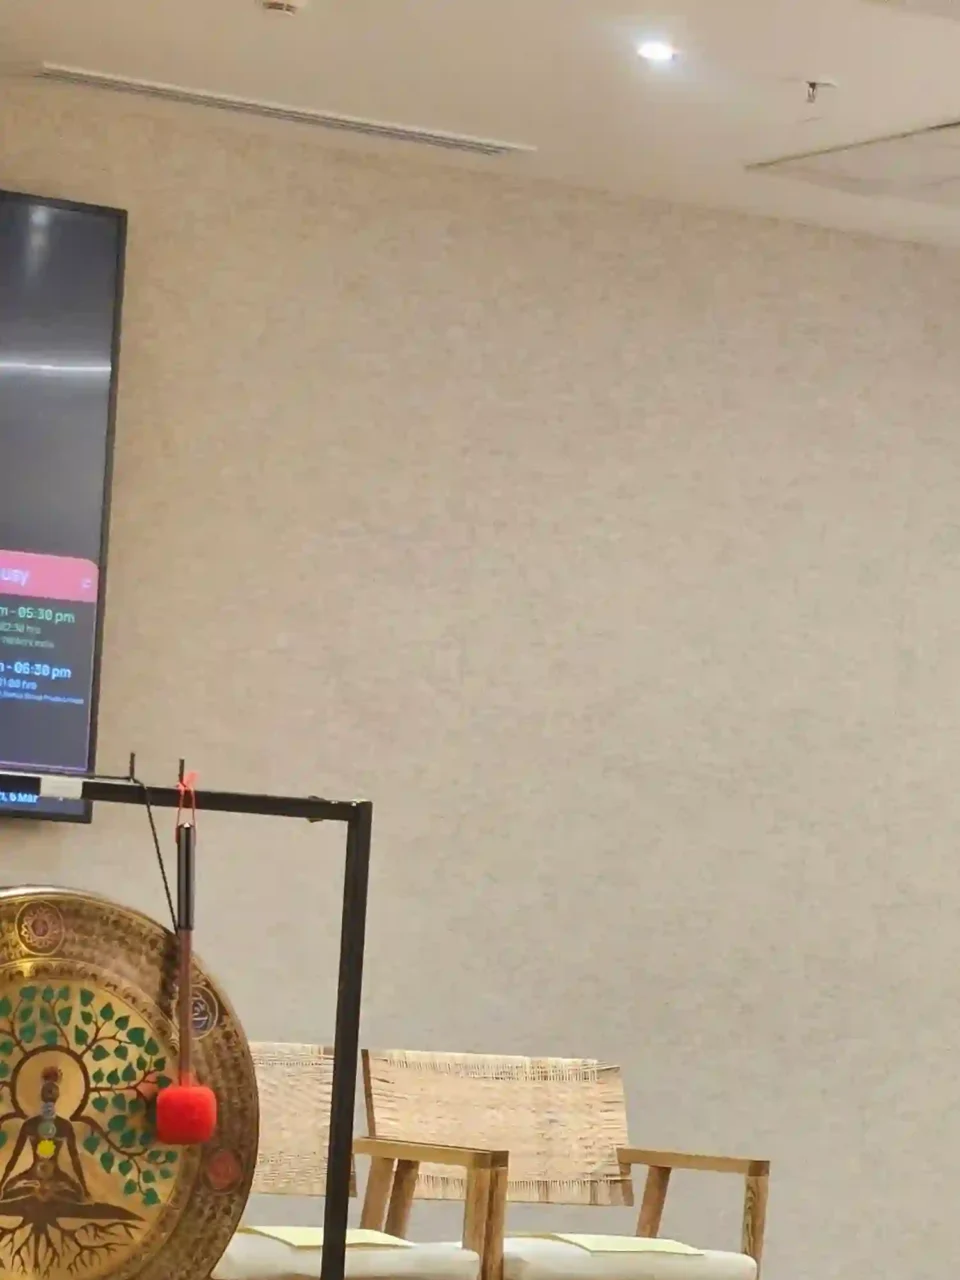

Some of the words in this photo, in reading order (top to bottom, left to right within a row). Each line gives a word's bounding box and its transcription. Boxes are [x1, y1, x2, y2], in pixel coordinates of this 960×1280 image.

[0, 566, 29, 587] usy
[18, 606, 53, 621] 05:30
[55, 611, 75, 625] pm
[14, 661, 51, 677] 06:30
[51, 667, 72, 680] pm
